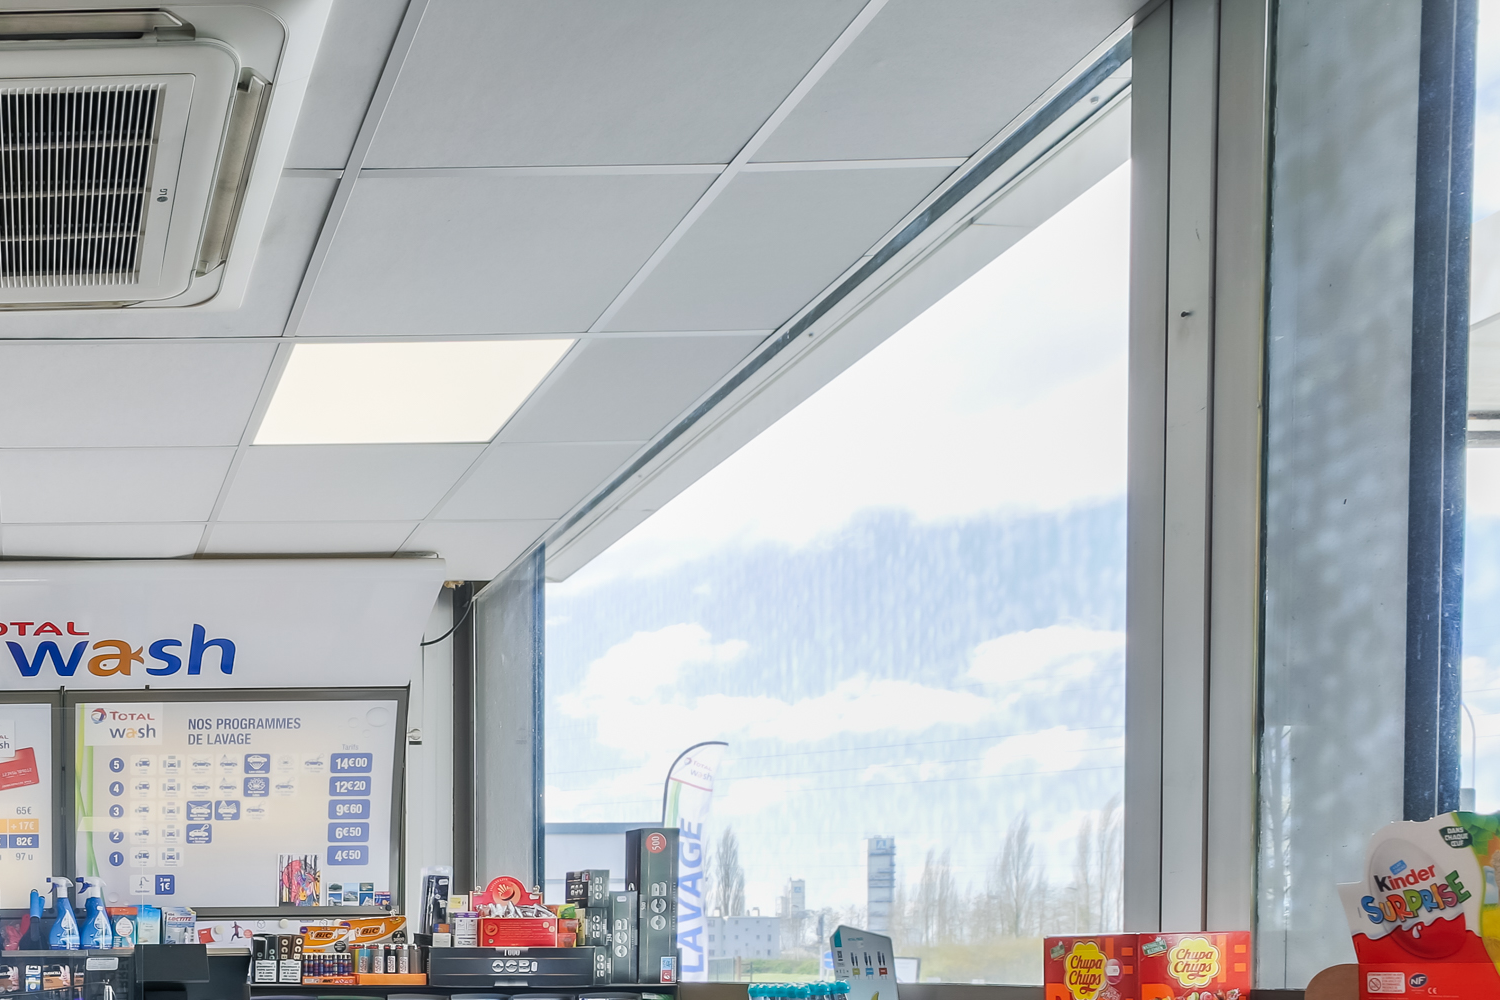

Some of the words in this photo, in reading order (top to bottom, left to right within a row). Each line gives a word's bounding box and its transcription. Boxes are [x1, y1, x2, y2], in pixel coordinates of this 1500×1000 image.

[5, 623, 237, 678] wash
[109, 711, 155, 721] TOTAL
[188, 718, 212, 730] NOS
[216, 717, 301, 730] PROGRAMMES
[109, 724, 156, 739] wash
[188, 733, 203, 745] DE
[207, 733, 251, 745] LAVAGE
[16, 806, 32, 815] 65€
[1444, 832, 1468, 841] CHAQUE
[1447, 826, 1464, 834] DANS
[16, 837, 33, 846] 82€
[652, 835, 662, 851] 500
[16, 852, 27, 861] 97
[160, 882, 171, 891] 1€
[676, 816, 705, 973] LAVAGE
[1361, 869, 1472, 924] SURPRISE
[651, 880, 668, 931] OCB
[614, 917, 629, 958] OCB
[1176, 949, 1214, 960] Chupa
[491, 959, 531, 974] OCB
[1070, 955, 1103, 970] Chupa
[1174, 960, 1212, 980] Chups
[1068, 970, 1102, 994] Chups
